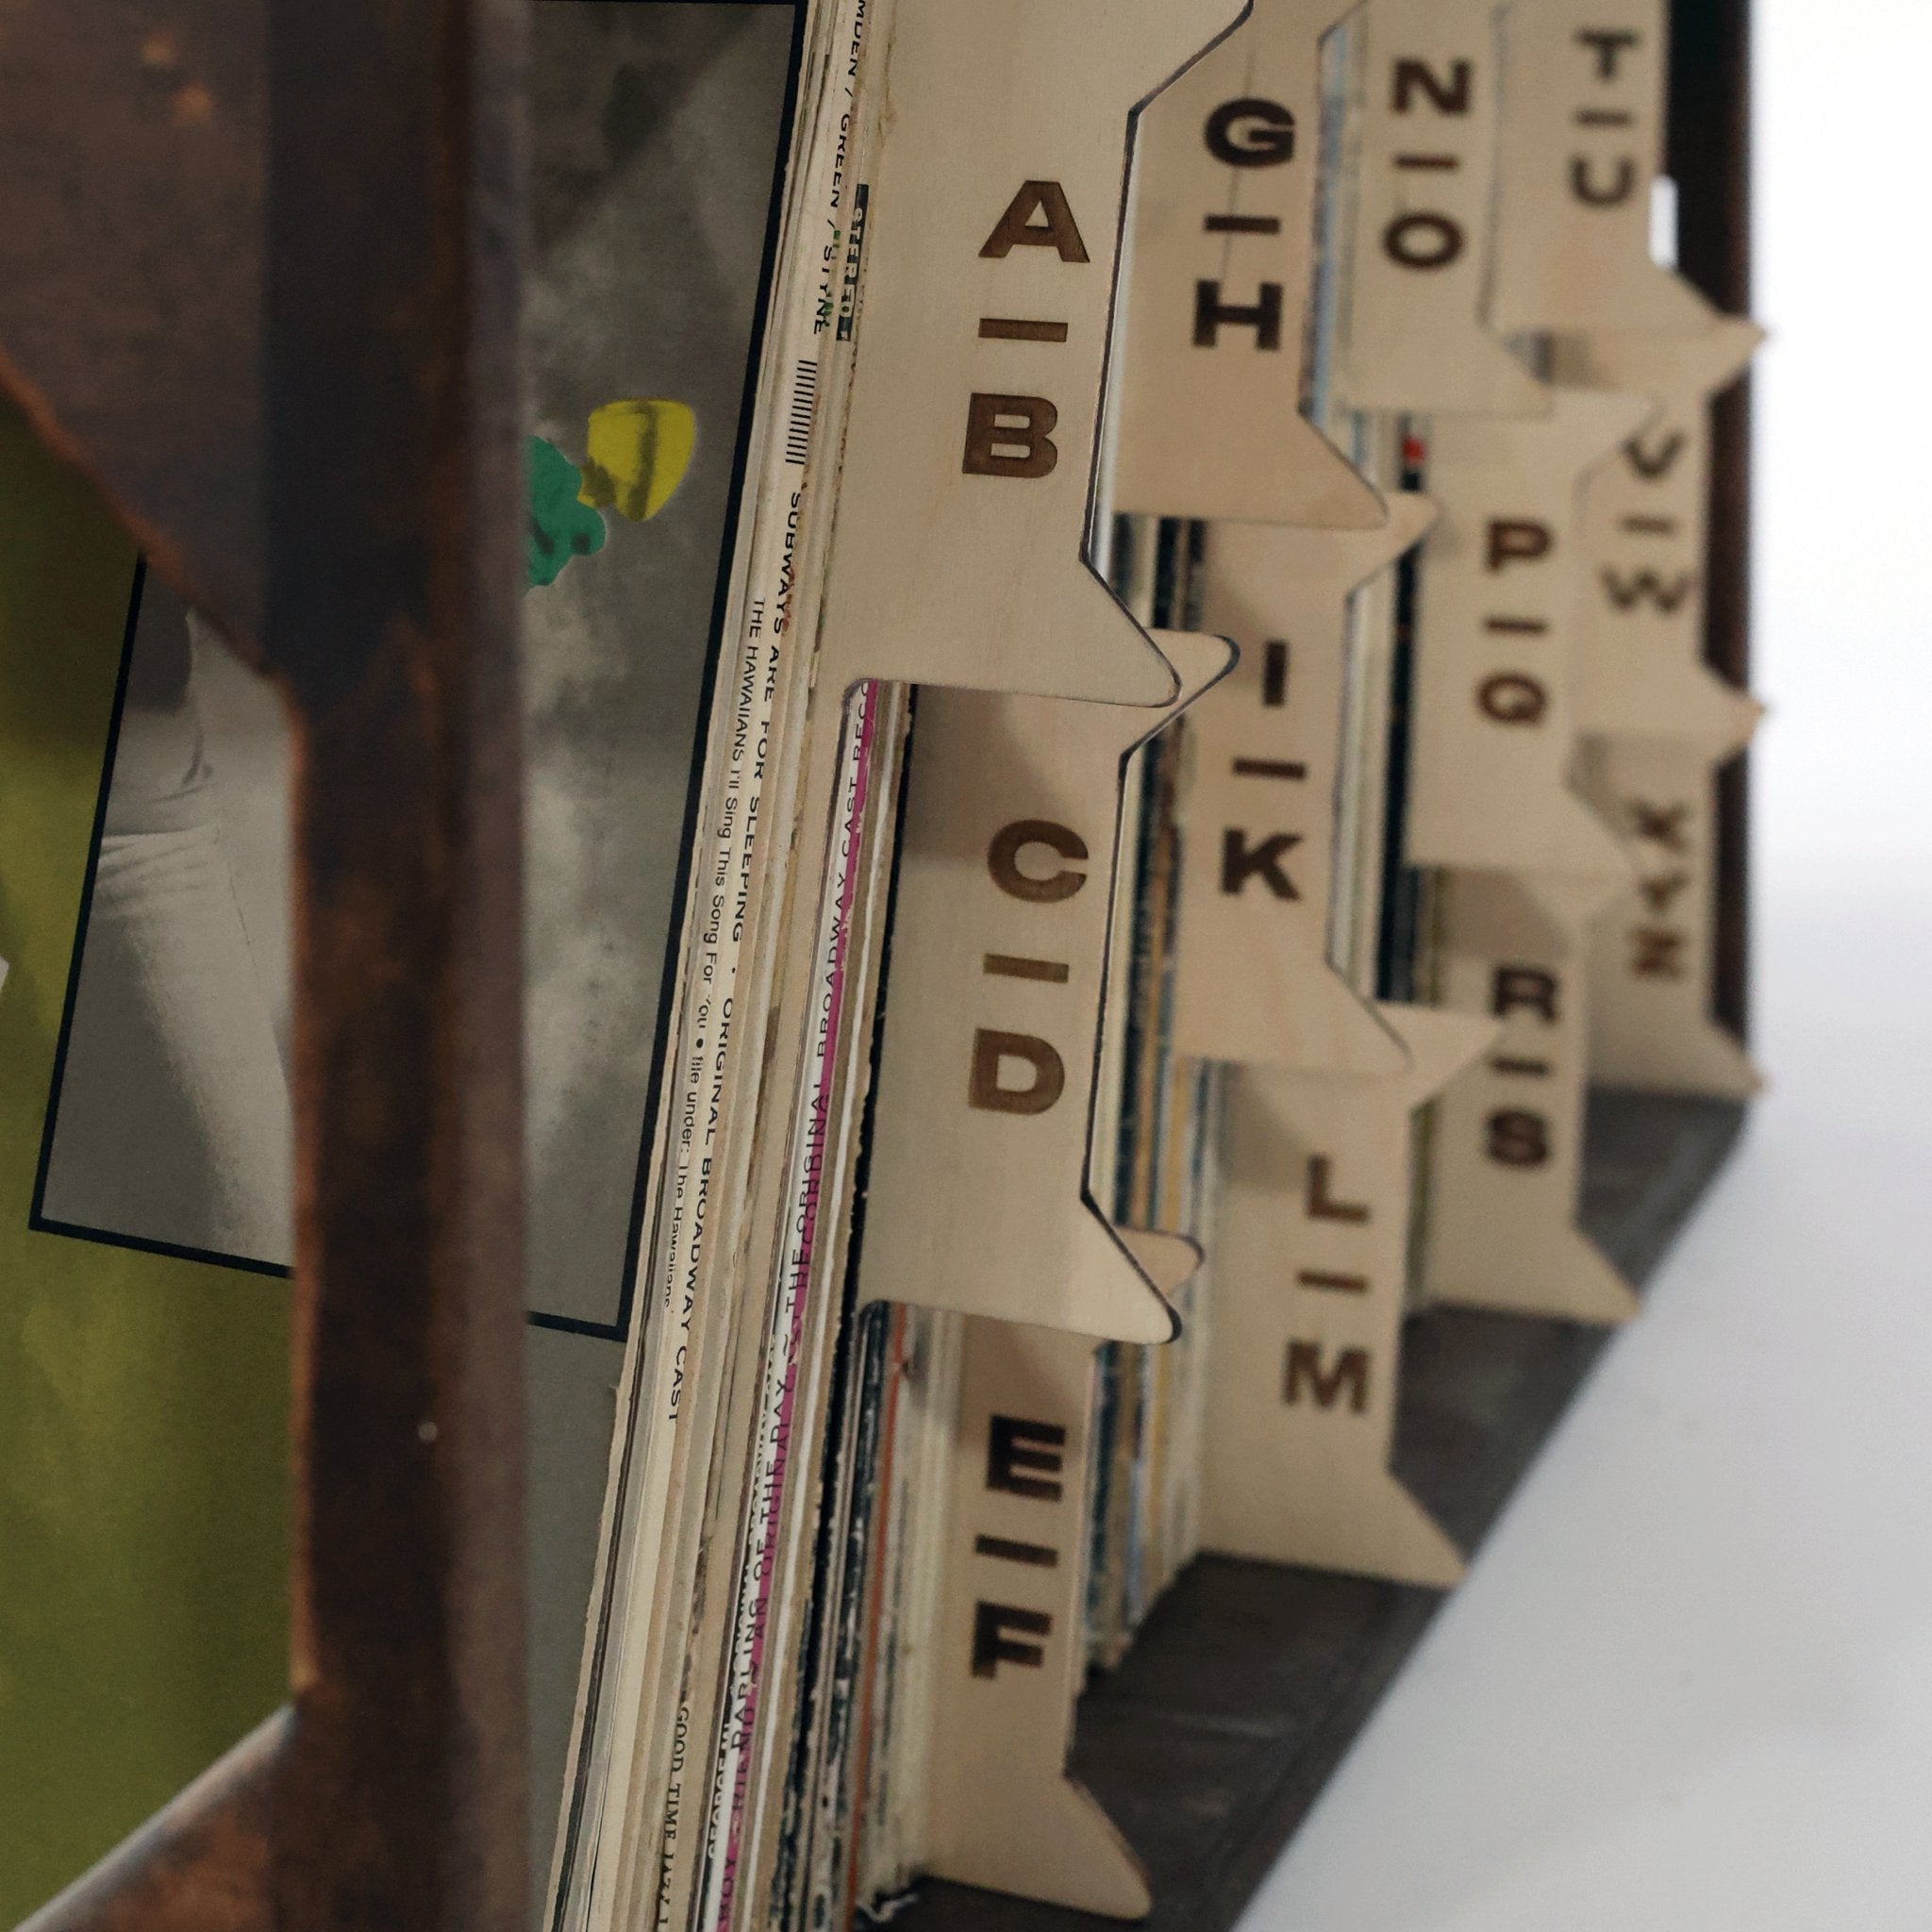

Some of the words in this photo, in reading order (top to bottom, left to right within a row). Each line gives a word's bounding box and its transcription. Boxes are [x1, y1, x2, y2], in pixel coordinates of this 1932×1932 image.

[1391, 58, 1472, 116] N
[1573, 27, 1640, 82] T
[830, 113, 850, 208] GREEN
[1205, 97, 1295, 167] G
[1571, 156, 1635, 208] U
[978, 180, 1091, 263] A
[1382, 211, 1465, 271] O
[839, 208, 863, 319] STEREO
[1192, 279, 1283, 351] H
[962, 392, 1058, 478] B
[1620, 430, 1686, 480] V
[774, 491, 801, 635] SUBWAYS
[1487, 518, 1553, 574] P
[749, 597, 765, 639] THE
[1601, 566, 1695, 618] W
[732, 645, 758, 761] HAWAIIANS
[764, 644, 779, 703] ARE
[1475, 672, 1547, 728] Q
[754, 720, 770, 780] FOR
[717, 797, 739, 839] Sing
[841, 776, 858, 858] CAST
[715, 846, 732, 886] This
[732, 795, 759, 943] SLEEPING
[988, 819, 1089, 903] C
[1220, 826, 1303, 902] K
[703, 894, 724, 943] Song
[703, 952, 717, 985] For
[817, 872, 846, 1058] BROADWAY
[1493, 965, 1557, 1024] R
[706, 997, 734, 1146] ORIGINAL
[968, 1028, 1065, 1115] D
[680, 1091, 698, 1154] under:
[797, 1083, 822, 1242] ORIGINAL
[797, 1092, 829, 1290] RECORDING
[1306, 1153, 1370, 1224] L
[679, 1158, 711, 1332] BROADWAY
[786, 1249, 804, 1313] THE
[668, 1344, 688, 1421] CAST
[770, 1374, 790, 1443] DAY
[1284, 1341, 1369, 1413] M
[986, 1414, 1065, 1503] E
[759, 1463, 775, 1528] THE
[753, 1541, 766, 1581] OF
[971, 1600, 1052, 1679] F
[730, 1600, 757, 1750] DARLING
[670, 1706, 689, 1773] GOOD
[663, 1783, 681, 1840] TIME
